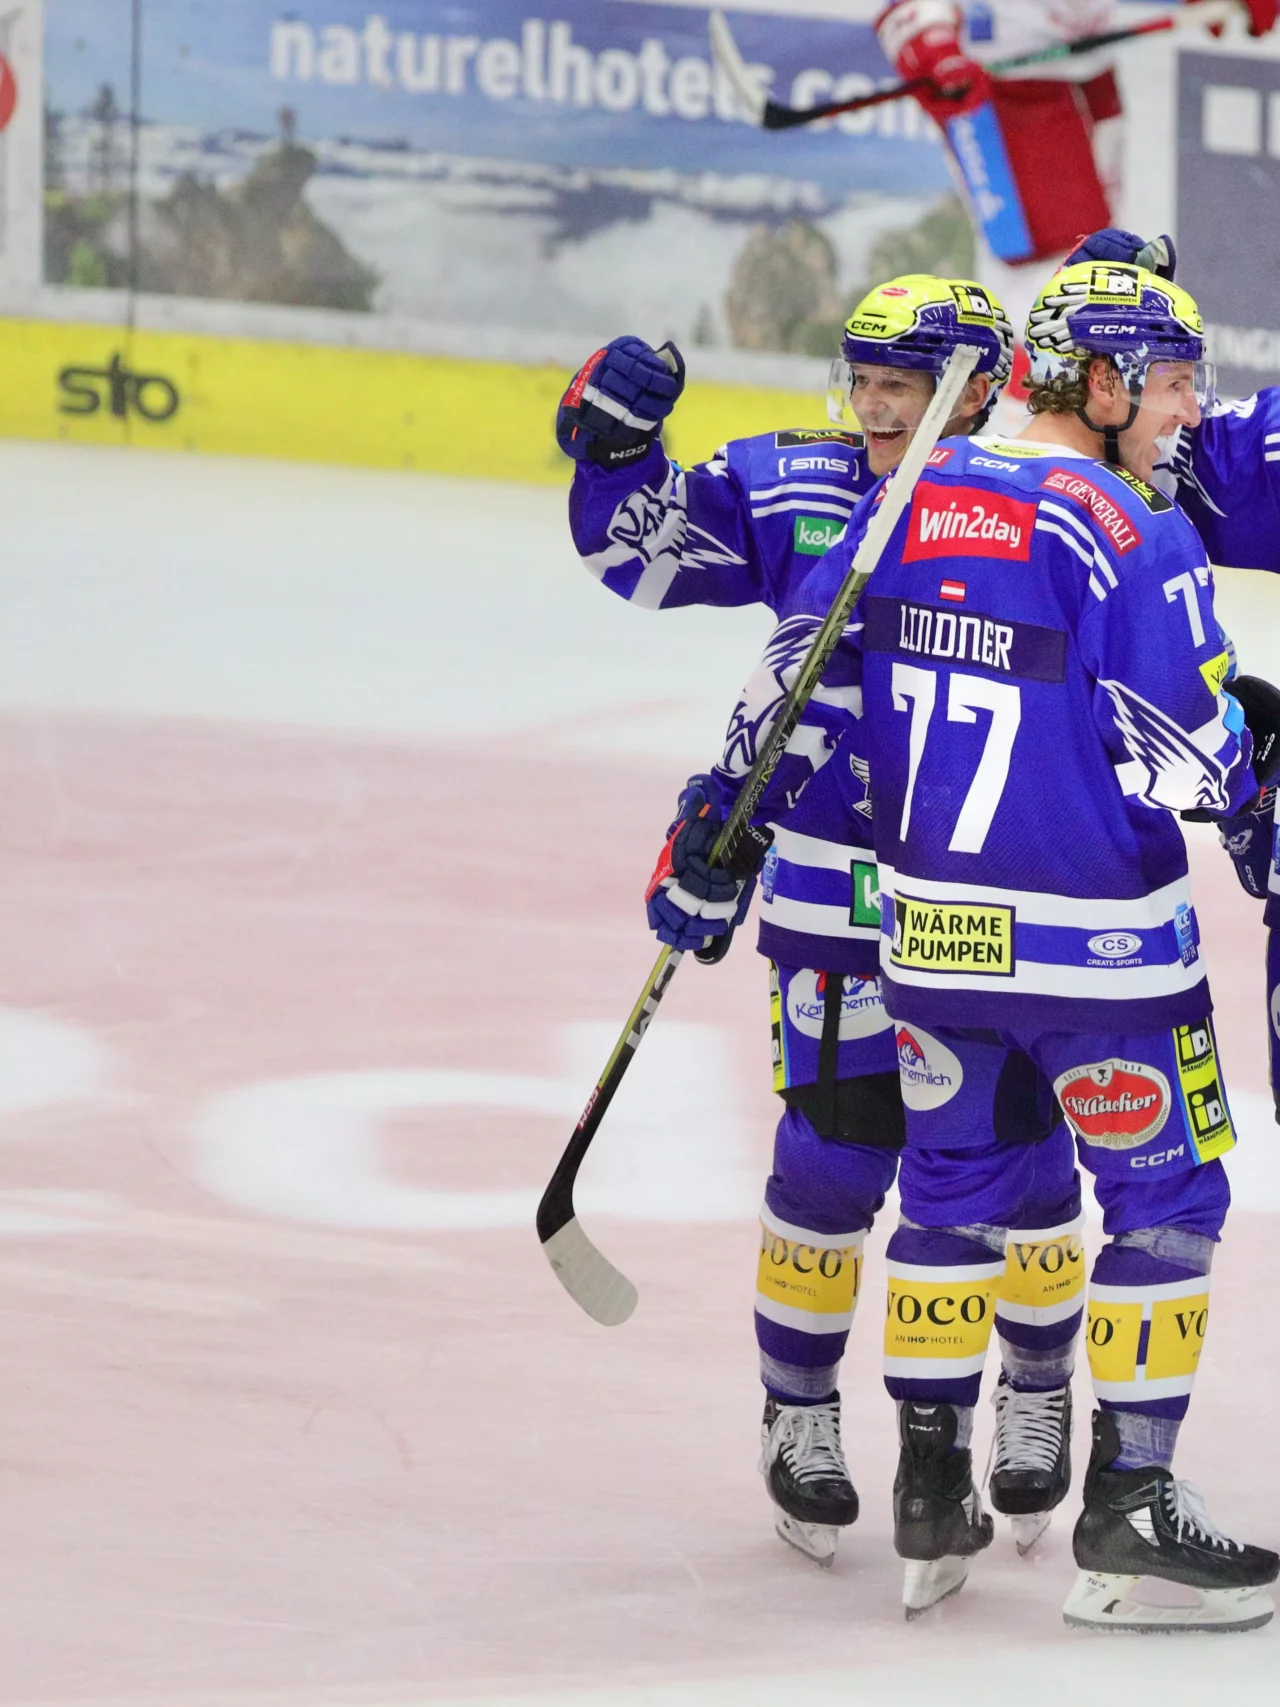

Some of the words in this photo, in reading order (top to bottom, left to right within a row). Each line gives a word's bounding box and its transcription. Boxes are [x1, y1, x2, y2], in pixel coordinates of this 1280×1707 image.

[850, 319, 887, 333] CCM
[1089, 324, 1137, 334] CCM
[56, 354, 181, 422] sto
[609, 444, 647, 460] CCM
[970, 456, 1021, 473] CCM
[1066, 478, 1137, 550] GENERALI
[900, 604, 1014, 671] LINDNER
[892, 662, 1021, 854] 77
[745, 824, 769, 846] CCM
[1244, 864, 1260, 893] CCM
[910, 909, 1003, 937] WÄRME
[908, 938, 1003, 964] PUMPEN
[1102, 938, 1128, 951] CS
[1087, 958, 1142, 966] CREATE-SPORTS
[1065, 1092, 1157, 1117] Villacher
[1130, 1144, 1185, 1168] CCM
[790, 1284, 818, 1298] HOTEL
[1043, 1285, 1055, 1293] AN
[1056, 1279, 1071, 1290] IHG
[895, 1335, 906, 1344] AN
[907, 1336, 927, 1344] IHG
[931, 1336, 964, 1345] HOTEL
